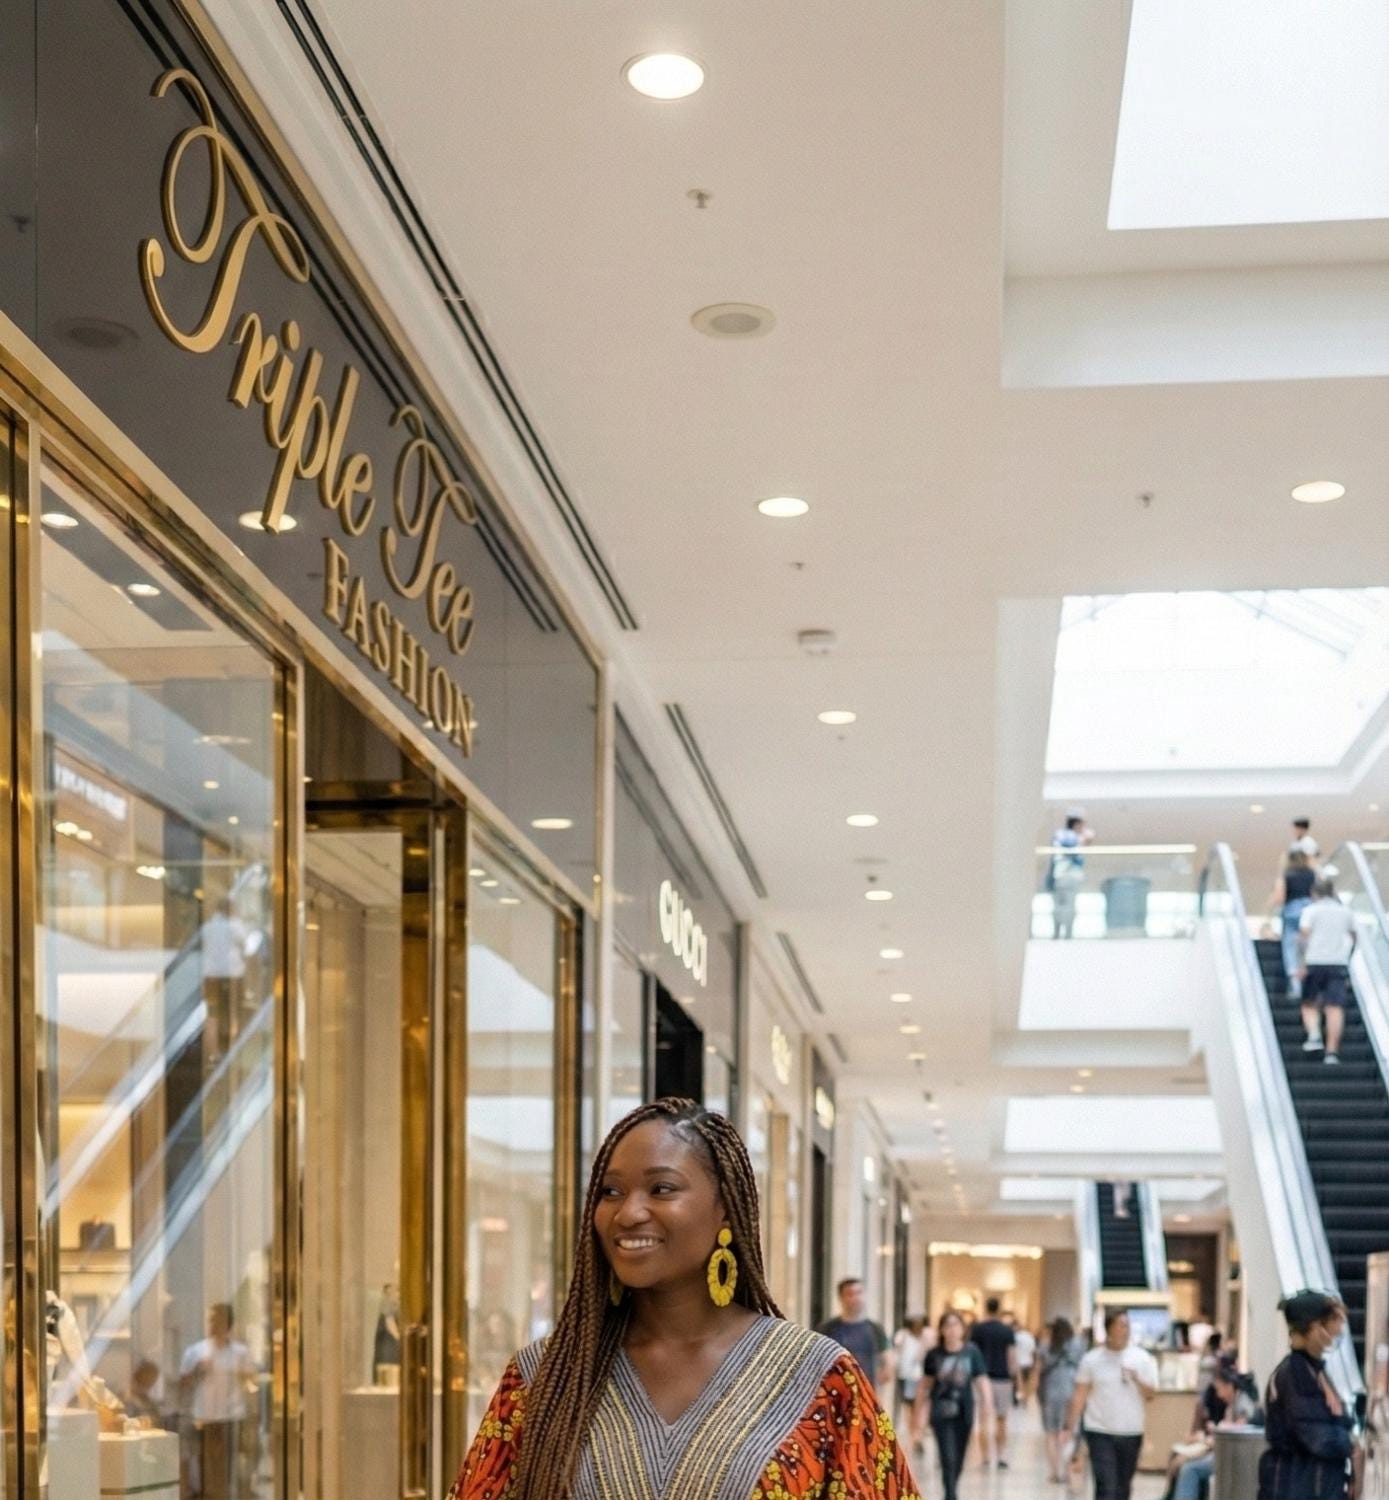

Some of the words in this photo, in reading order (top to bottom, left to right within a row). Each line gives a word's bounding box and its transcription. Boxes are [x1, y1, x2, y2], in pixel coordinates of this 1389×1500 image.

[137, 67, 376, 536] Triple
[381, 404, 478, 656] Tee
[323, 536, 478, 758] FASHION
[659, 879, 707, 987] GUCCI
